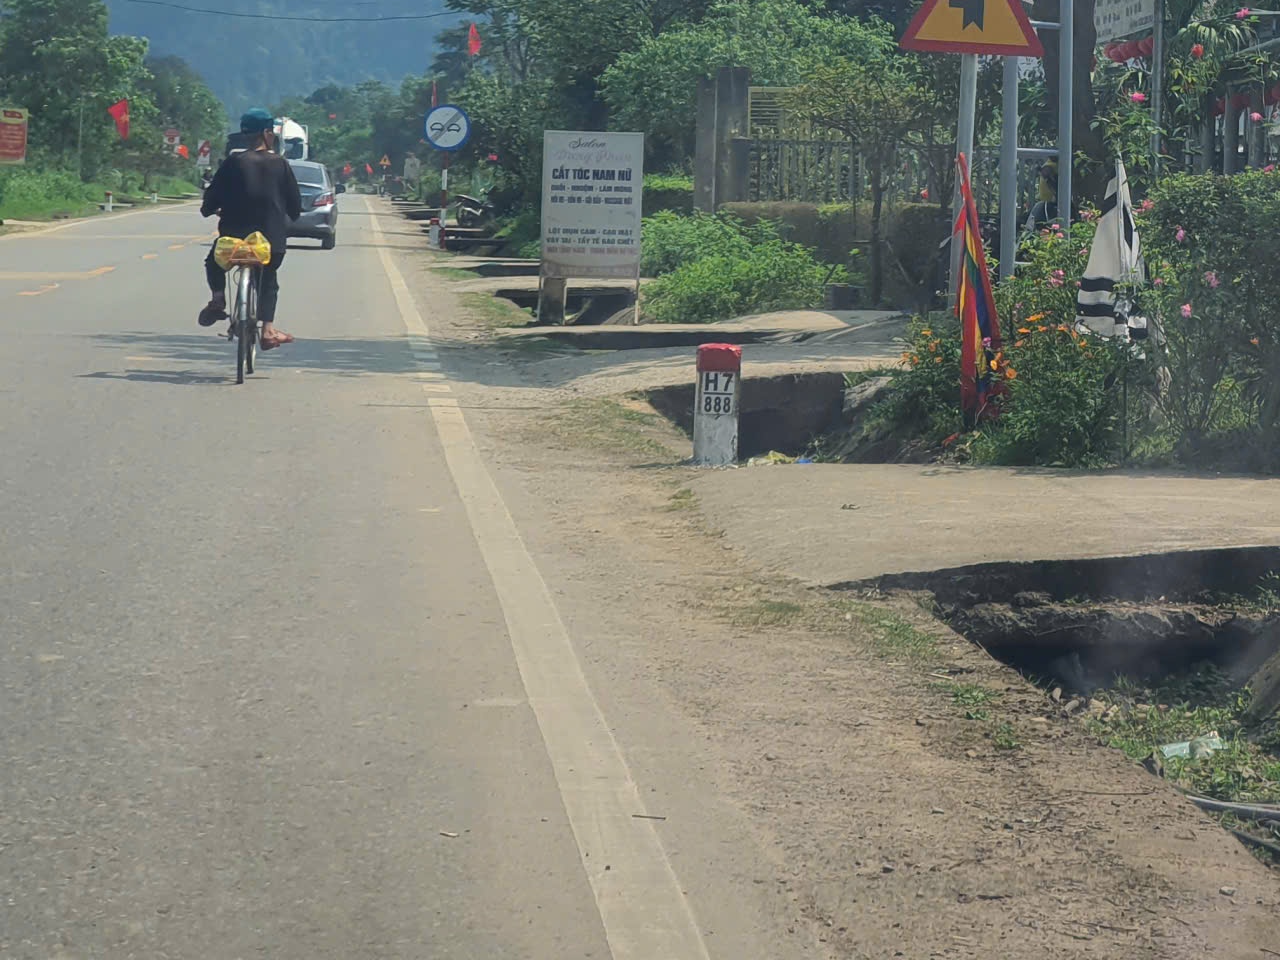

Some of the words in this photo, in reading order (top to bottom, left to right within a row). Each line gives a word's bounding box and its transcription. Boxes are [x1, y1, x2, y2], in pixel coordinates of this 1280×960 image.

[552, 164, 570, 180] CẮT
[572, 166, 590, 180] TÓC
[592, 169, 616, 181] NAM
[618, 168, 632, 181] NỮ
[704, 372, 733, 391] H7
[704, 396, 731, 413] 888
